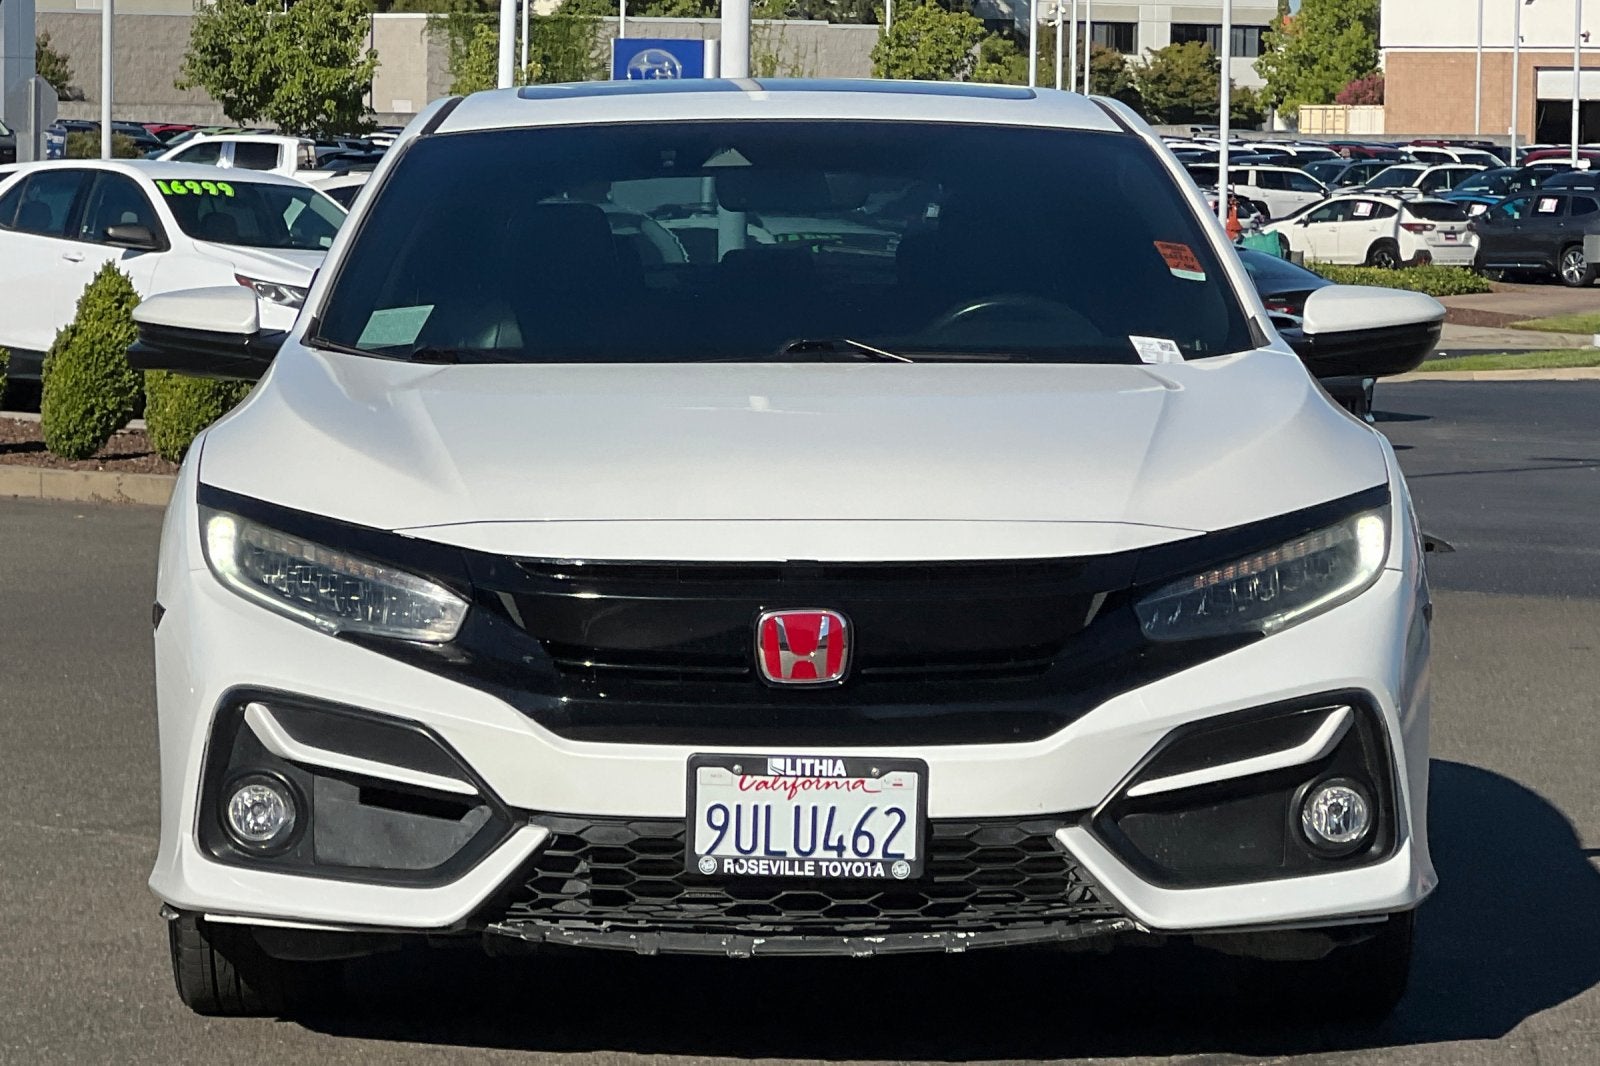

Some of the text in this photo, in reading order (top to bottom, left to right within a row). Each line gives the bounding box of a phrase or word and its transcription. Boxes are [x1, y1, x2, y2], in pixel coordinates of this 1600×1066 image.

[156, 180, 235, 197] 16999
[785, 758, 847, 777] LITHIA
[738, 775, 882, 800] California
[705, 803, 907, 859] 9ULU462
[723, 859, 885, 877] ROSEVILLE TOYOTA
